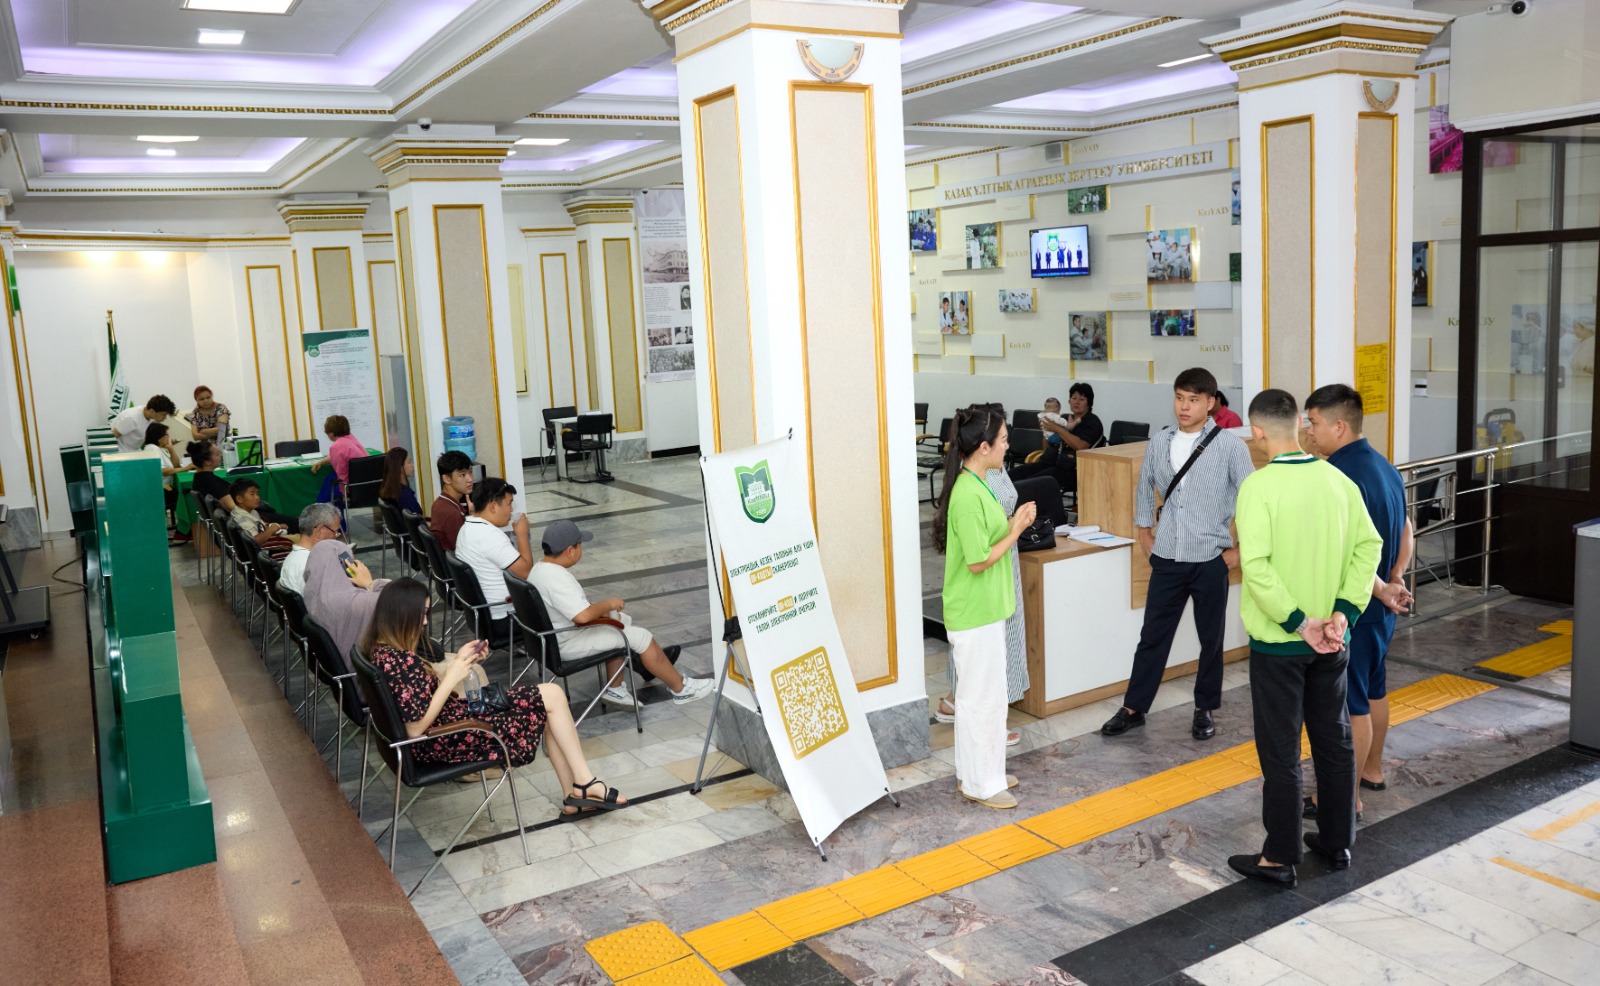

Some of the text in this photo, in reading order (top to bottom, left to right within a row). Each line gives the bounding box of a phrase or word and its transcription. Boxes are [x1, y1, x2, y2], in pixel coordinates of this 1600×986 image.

[1013, 173, 1067, 191] АГРАРЛЫҚ
[1067, 164, 1115, 183] ЗЕРТТЕУ
[1117, 150, 1213, 176] УНИВЕРСИТЕТІ
